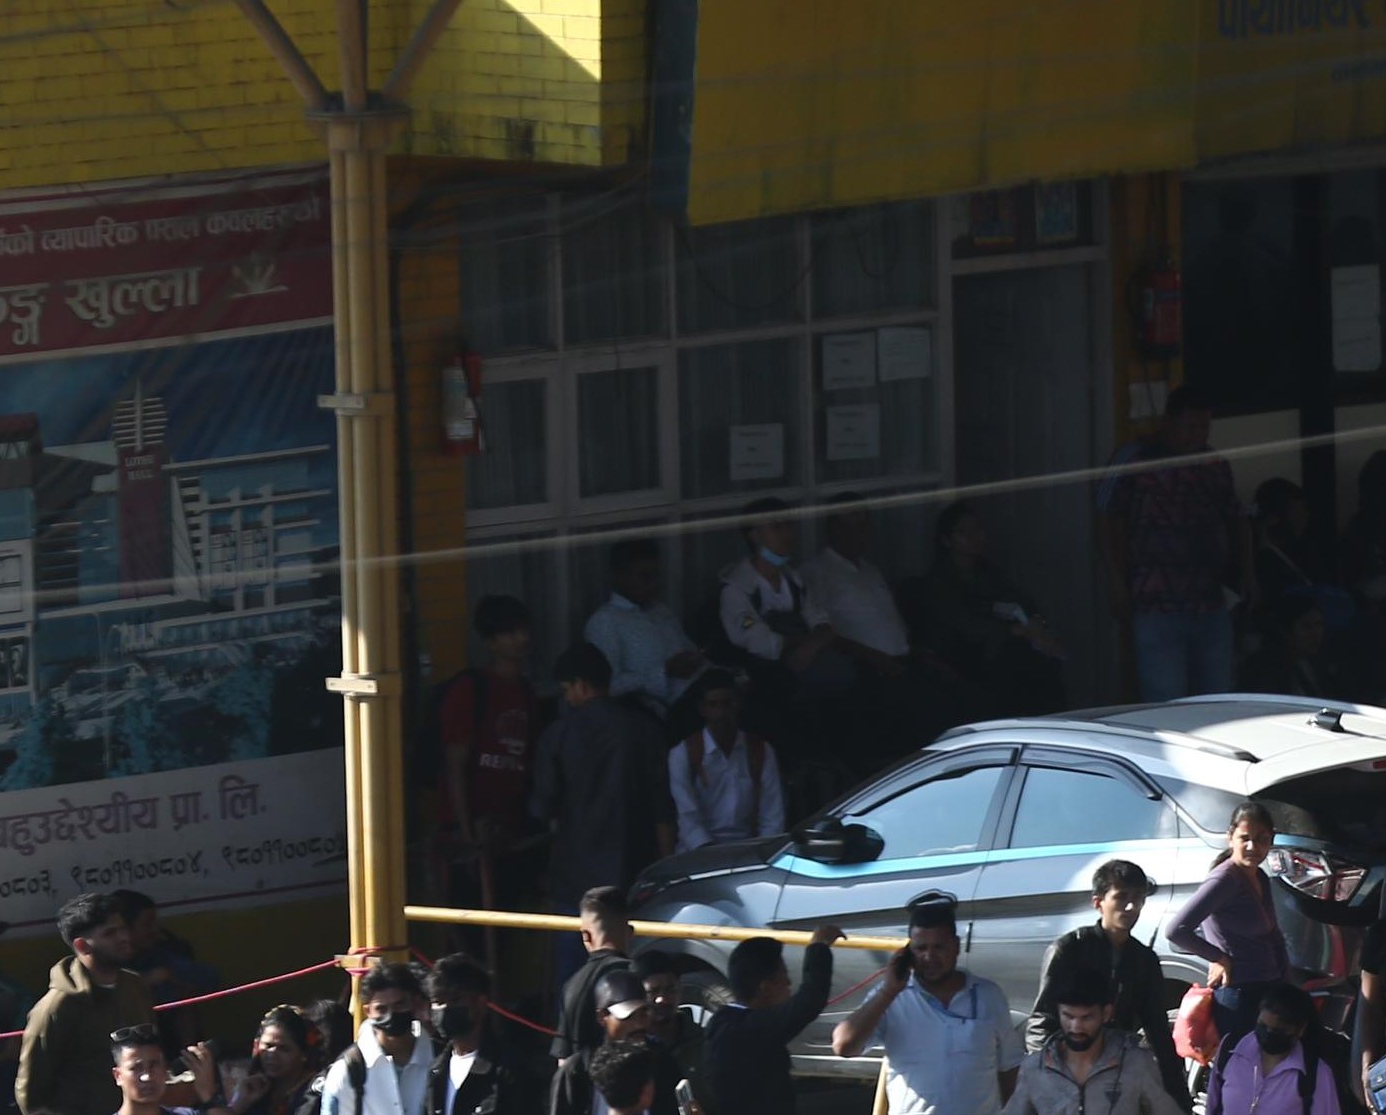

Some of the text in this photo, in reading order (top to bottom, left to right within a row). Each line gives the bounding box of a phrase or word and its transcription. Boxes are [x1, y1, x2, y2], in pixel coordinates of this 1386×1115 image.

[63, 266, 203, 328] खुल्ला
[169, 791, 208, 831] प्रा.
[218, 775, 267, 819] लि.
